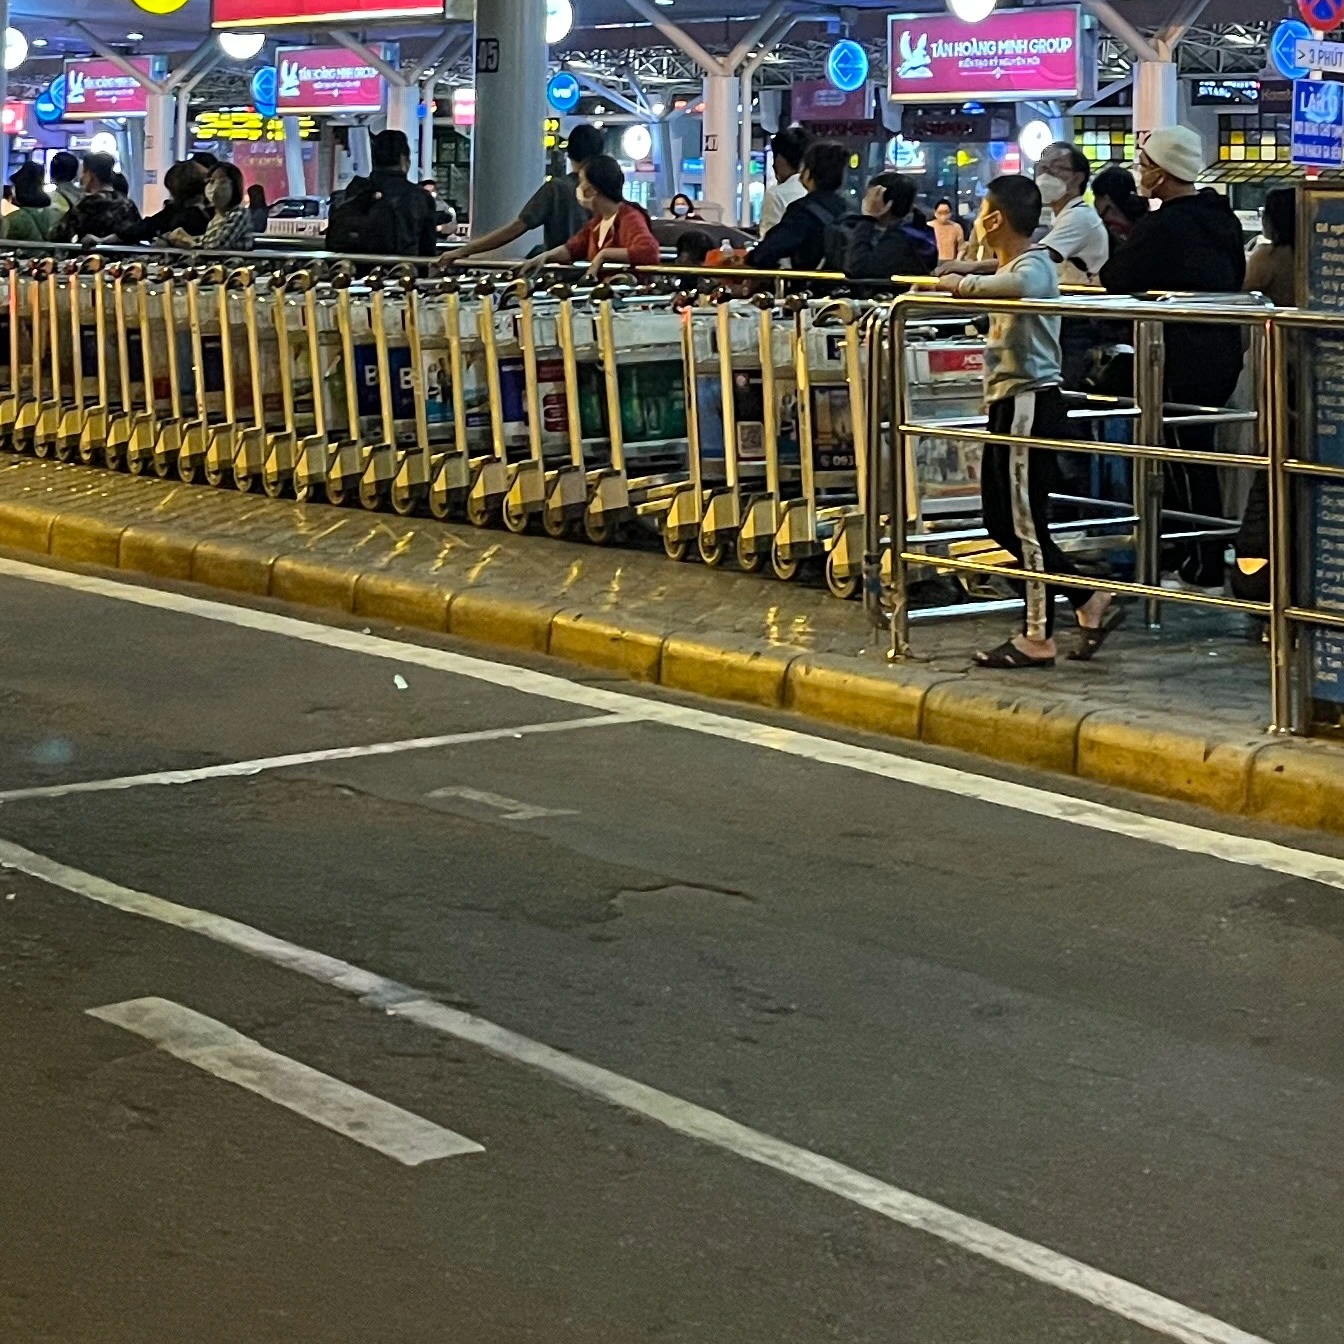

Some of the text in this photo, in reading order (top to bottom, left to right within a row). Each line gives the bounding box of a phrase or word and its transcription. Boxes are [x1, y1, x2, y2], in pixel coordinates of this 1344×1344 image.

[954, 37, 997, 57] HOÀNG
[998, 38, 1028, 55] MINH
[1028, 36, 1073, 54] GROUP
